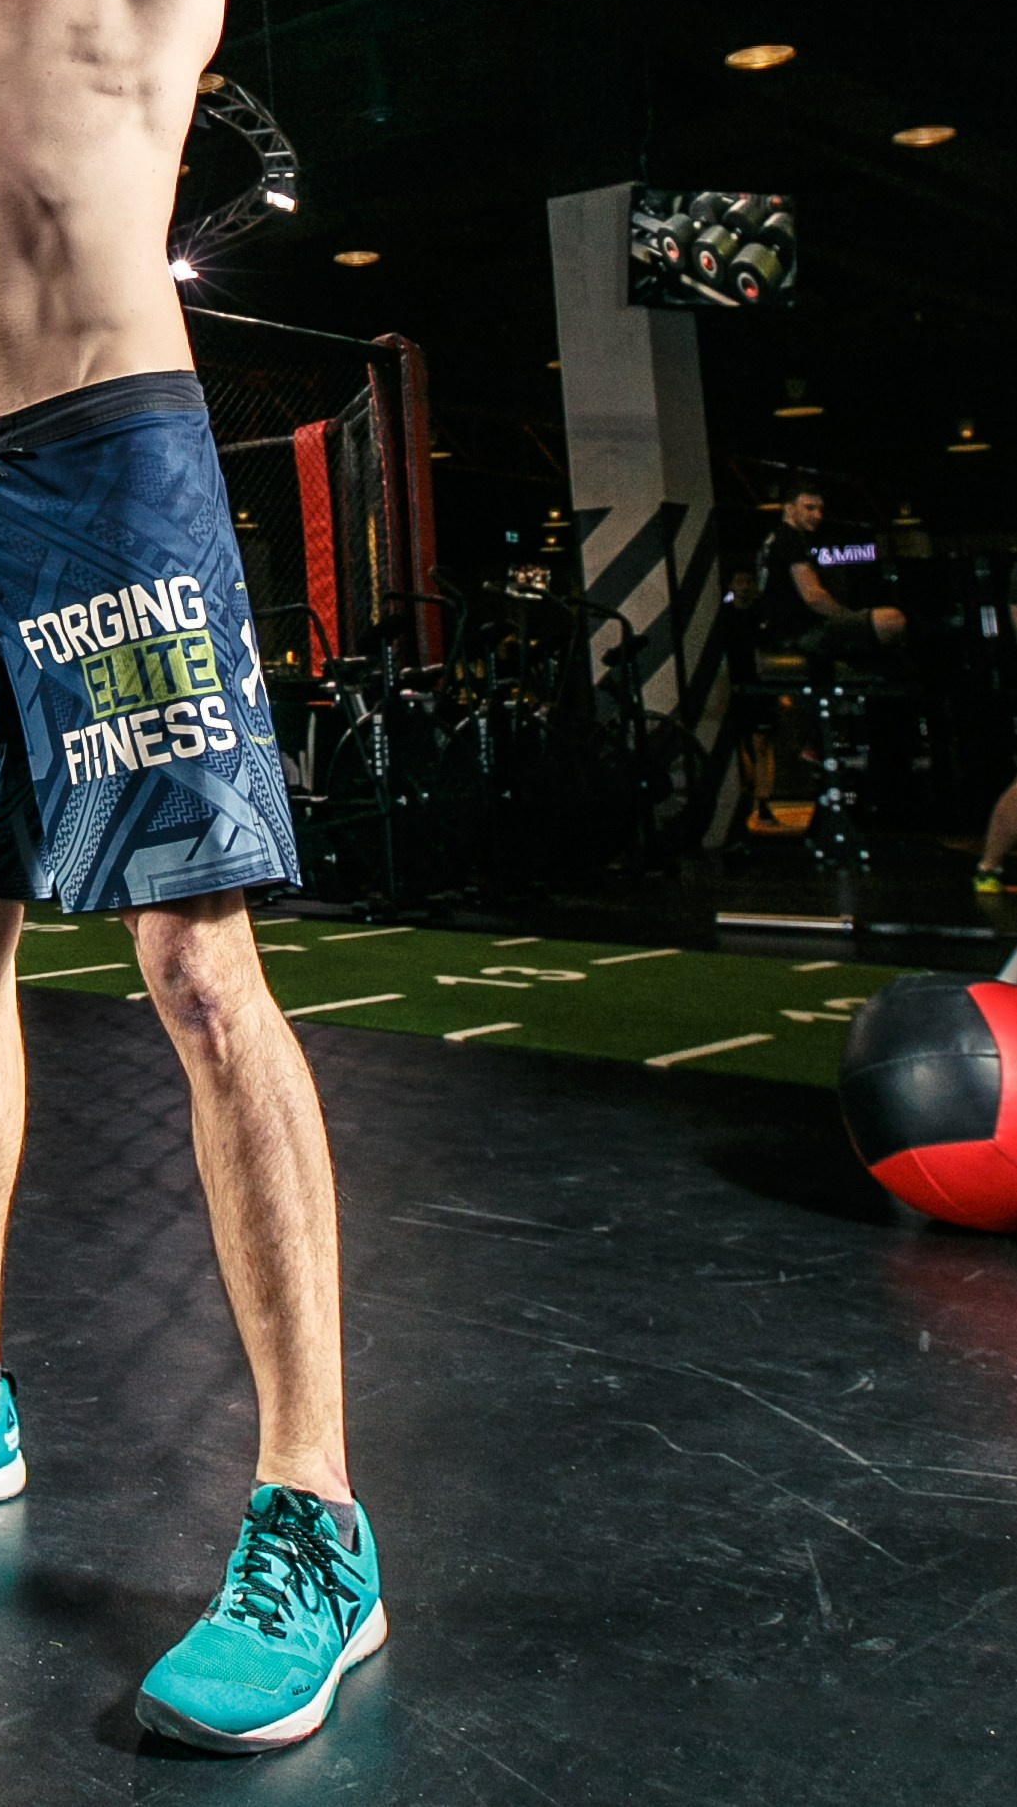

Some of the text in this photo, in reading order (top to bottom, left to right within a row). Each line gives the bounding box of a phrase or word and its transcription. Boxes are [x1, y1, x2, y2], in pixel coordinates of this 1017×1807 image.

[18, 575, 207, 670] FORGING
[82, 631, 220, 718] ELITE
[62, 695, 237, 785] FITNESS
[434, 966, 587, 989] 13
